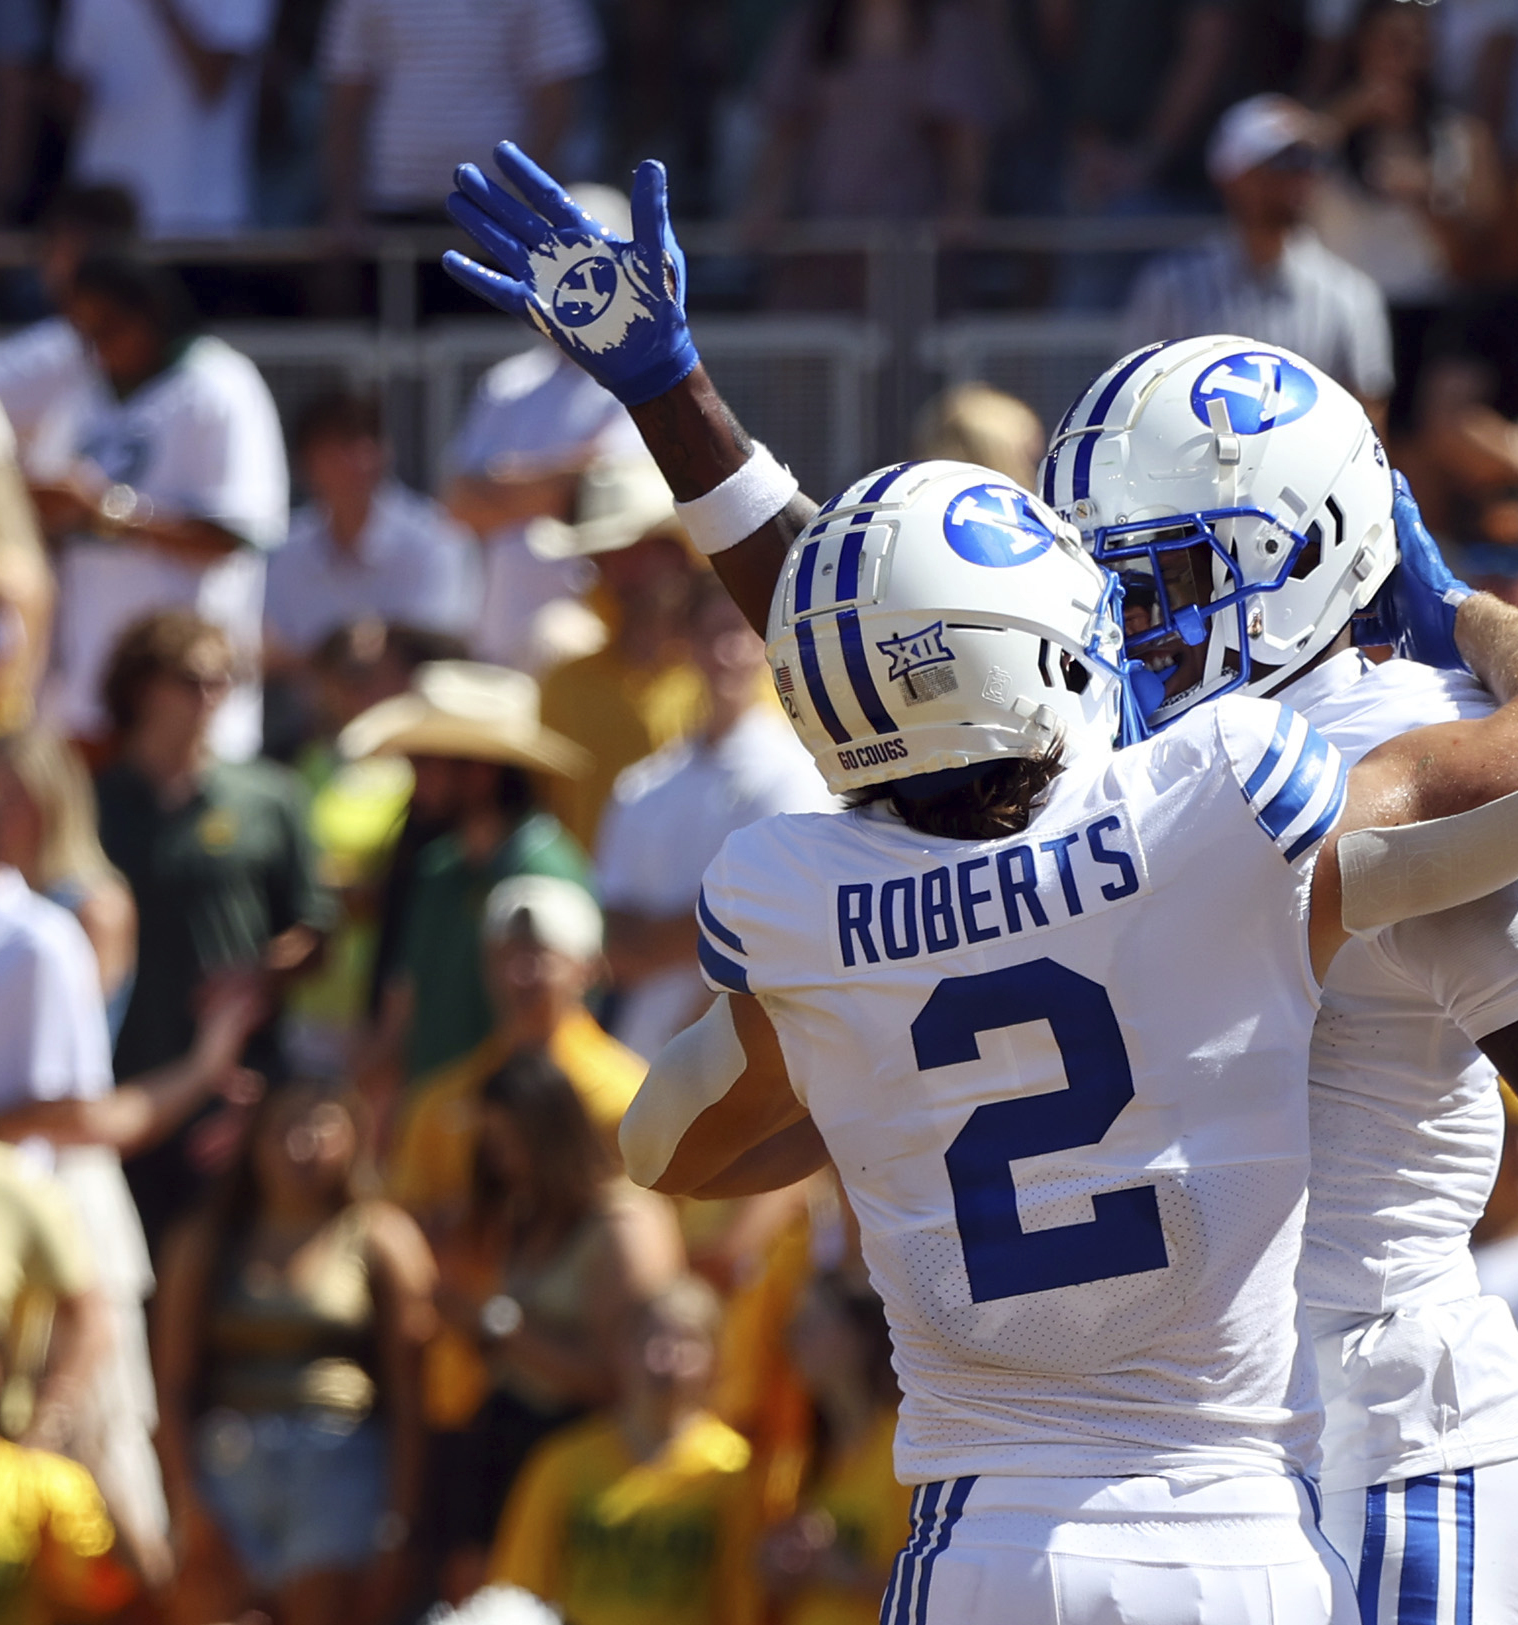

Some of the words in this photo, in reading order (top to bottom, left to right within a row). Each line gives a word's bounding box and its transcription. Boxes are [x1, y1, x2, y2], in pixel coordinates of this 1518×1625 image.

[837, 750, 858, 771] GO
[857, 738, 909, 768] COUGS
[836, 814, 1140, 968] ROBERTS
[910, 957, 1169, 1305] 2
